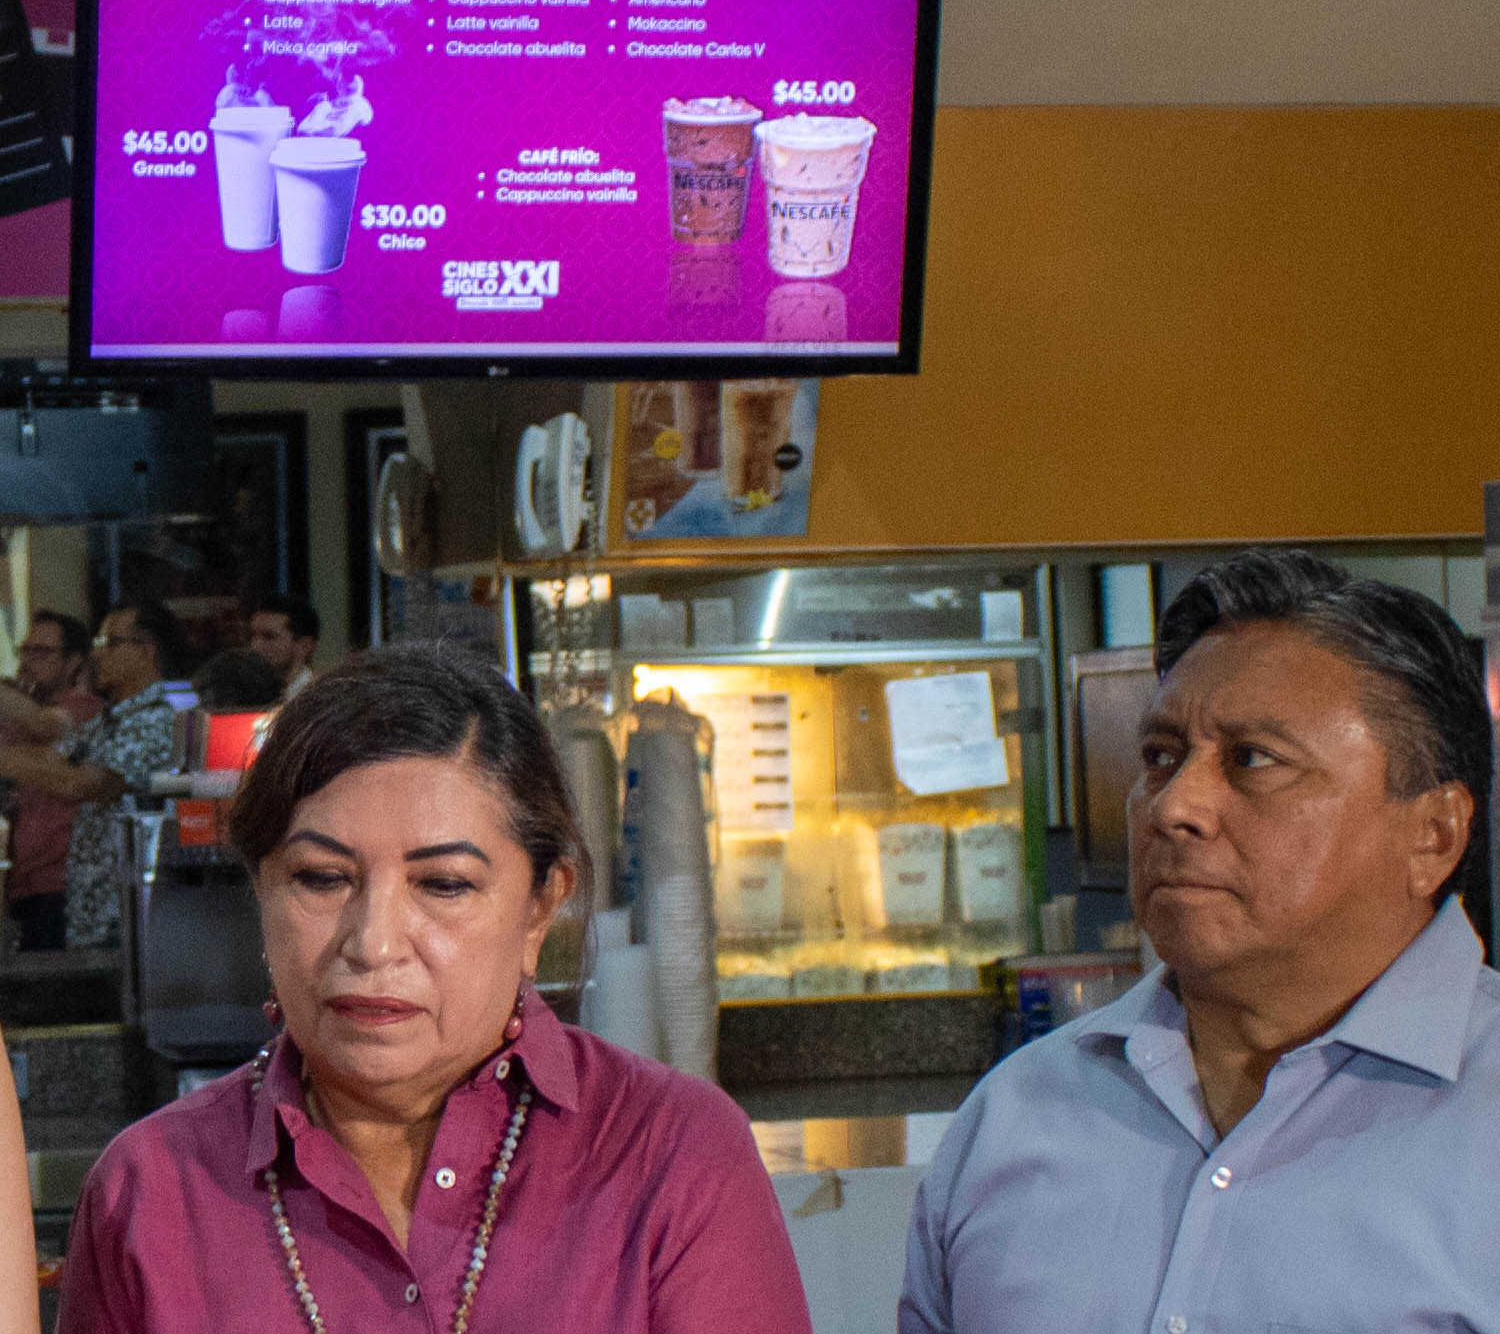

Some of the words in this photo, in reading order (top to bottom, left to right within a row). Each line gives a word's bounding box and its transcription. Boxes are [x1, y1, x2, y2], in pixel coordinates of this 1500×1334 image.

[264, 14, 303, 30] Latte
[447, 15, 486, 30] Latte
[488, 15, 540, 31] vainilla
[628, 16, 706, 32] Mokaccino
[263, 40, 302, 55] Moka
[446, 40, 522, 57] Chocolate
[626, 41, 703, 58] Chocolate
[705, 41, 751, 58] Carlos
[753, 42, 767, 58] V
[773, 80, 856, 106] $45.00
[122, 130, 208, 155] $45.00
[518, 147, 559, 165] CAFÉ
[132, 160, 197, 178] Grande
[497, 169, 573, 184] Chocolate
[496, 186, 585, 204] Cappuccino
[361, 203, 447, 229] $30.00
[378, 233, 427, 252] Chico
[442, 260, 499, 278] CINES
[499, 259, 560, 297] XXI
[442, 278, 499, 297] SIGLO
